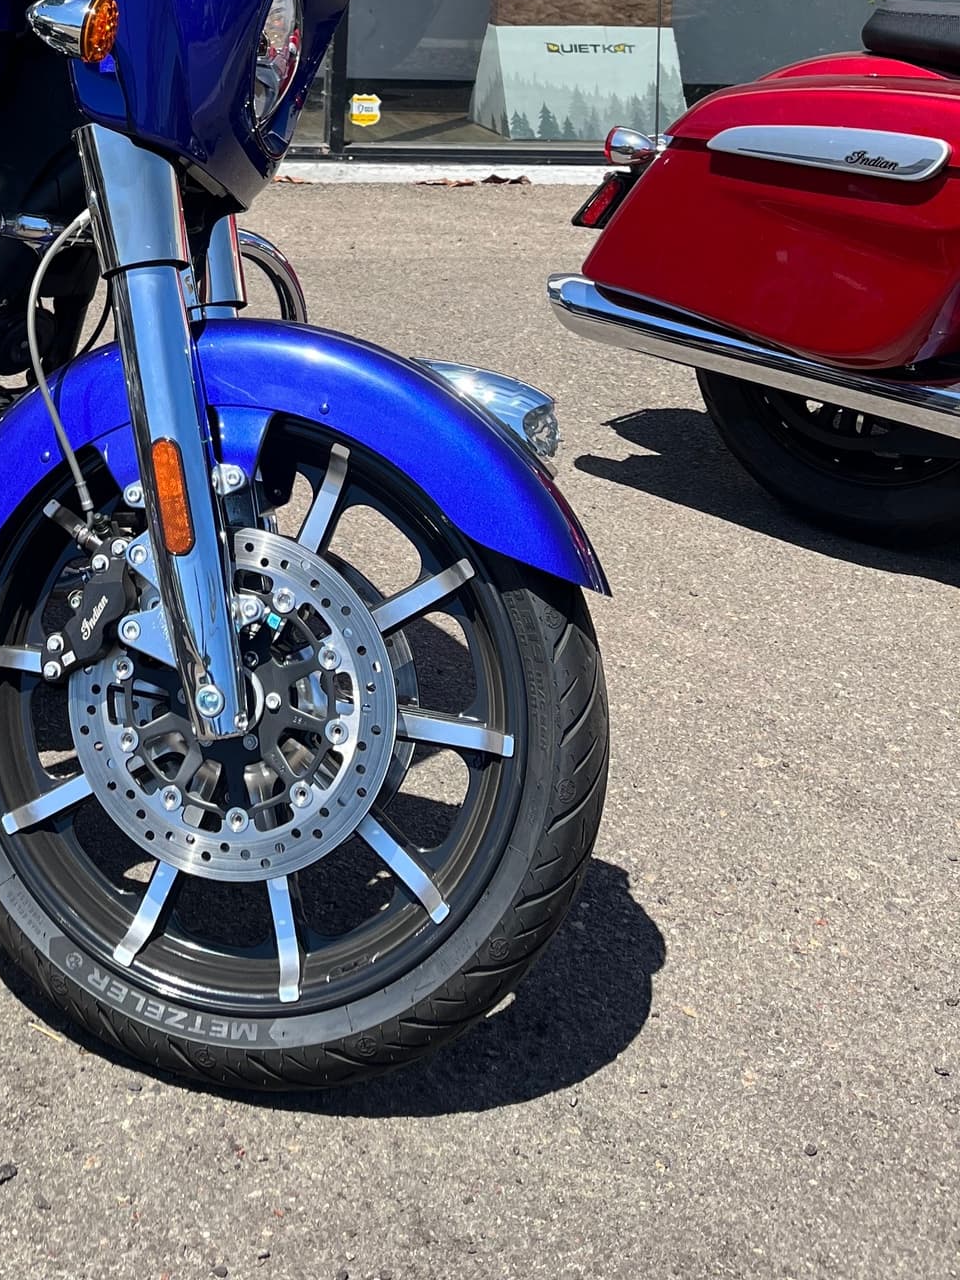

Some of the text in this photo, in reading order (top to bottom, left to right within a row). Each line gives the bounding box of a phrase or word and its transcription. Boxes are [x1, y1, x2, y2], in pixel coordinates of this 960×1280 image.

[544, 42, 636, 56] QUIETKAT
[844, 150, 899, 170] Indian
[81, 595, 108, 640] Indian
[87, 966, 258, 1041] METZELER
